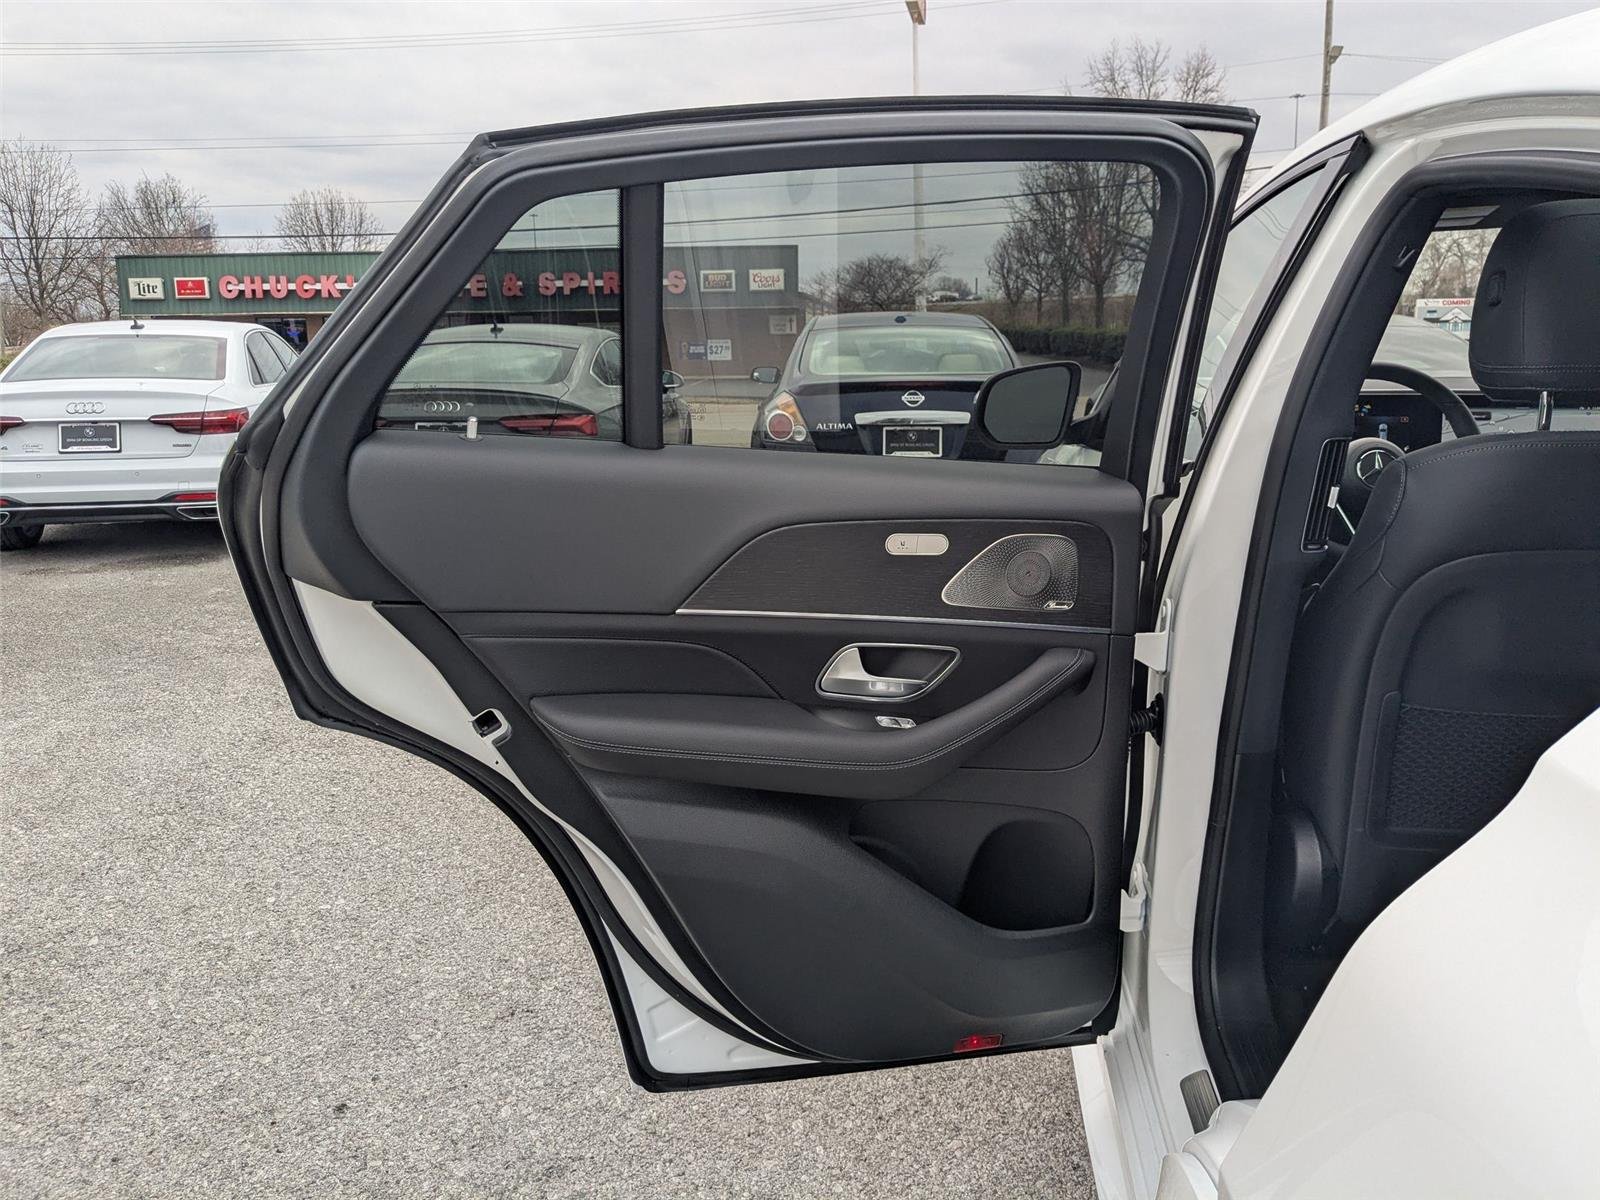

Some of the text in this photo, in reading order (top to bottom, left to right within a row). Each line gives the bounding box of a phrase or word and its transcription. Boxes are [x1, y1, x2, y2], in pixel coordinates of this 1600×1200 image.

[502, 271, 524, 297] &
[538, 270, 687, 296] SPIRS
[752, 272, 780, 284] Coors
[136, 282, 158, 297] Lite
[815, 422, 853, 431] ALTIMA
